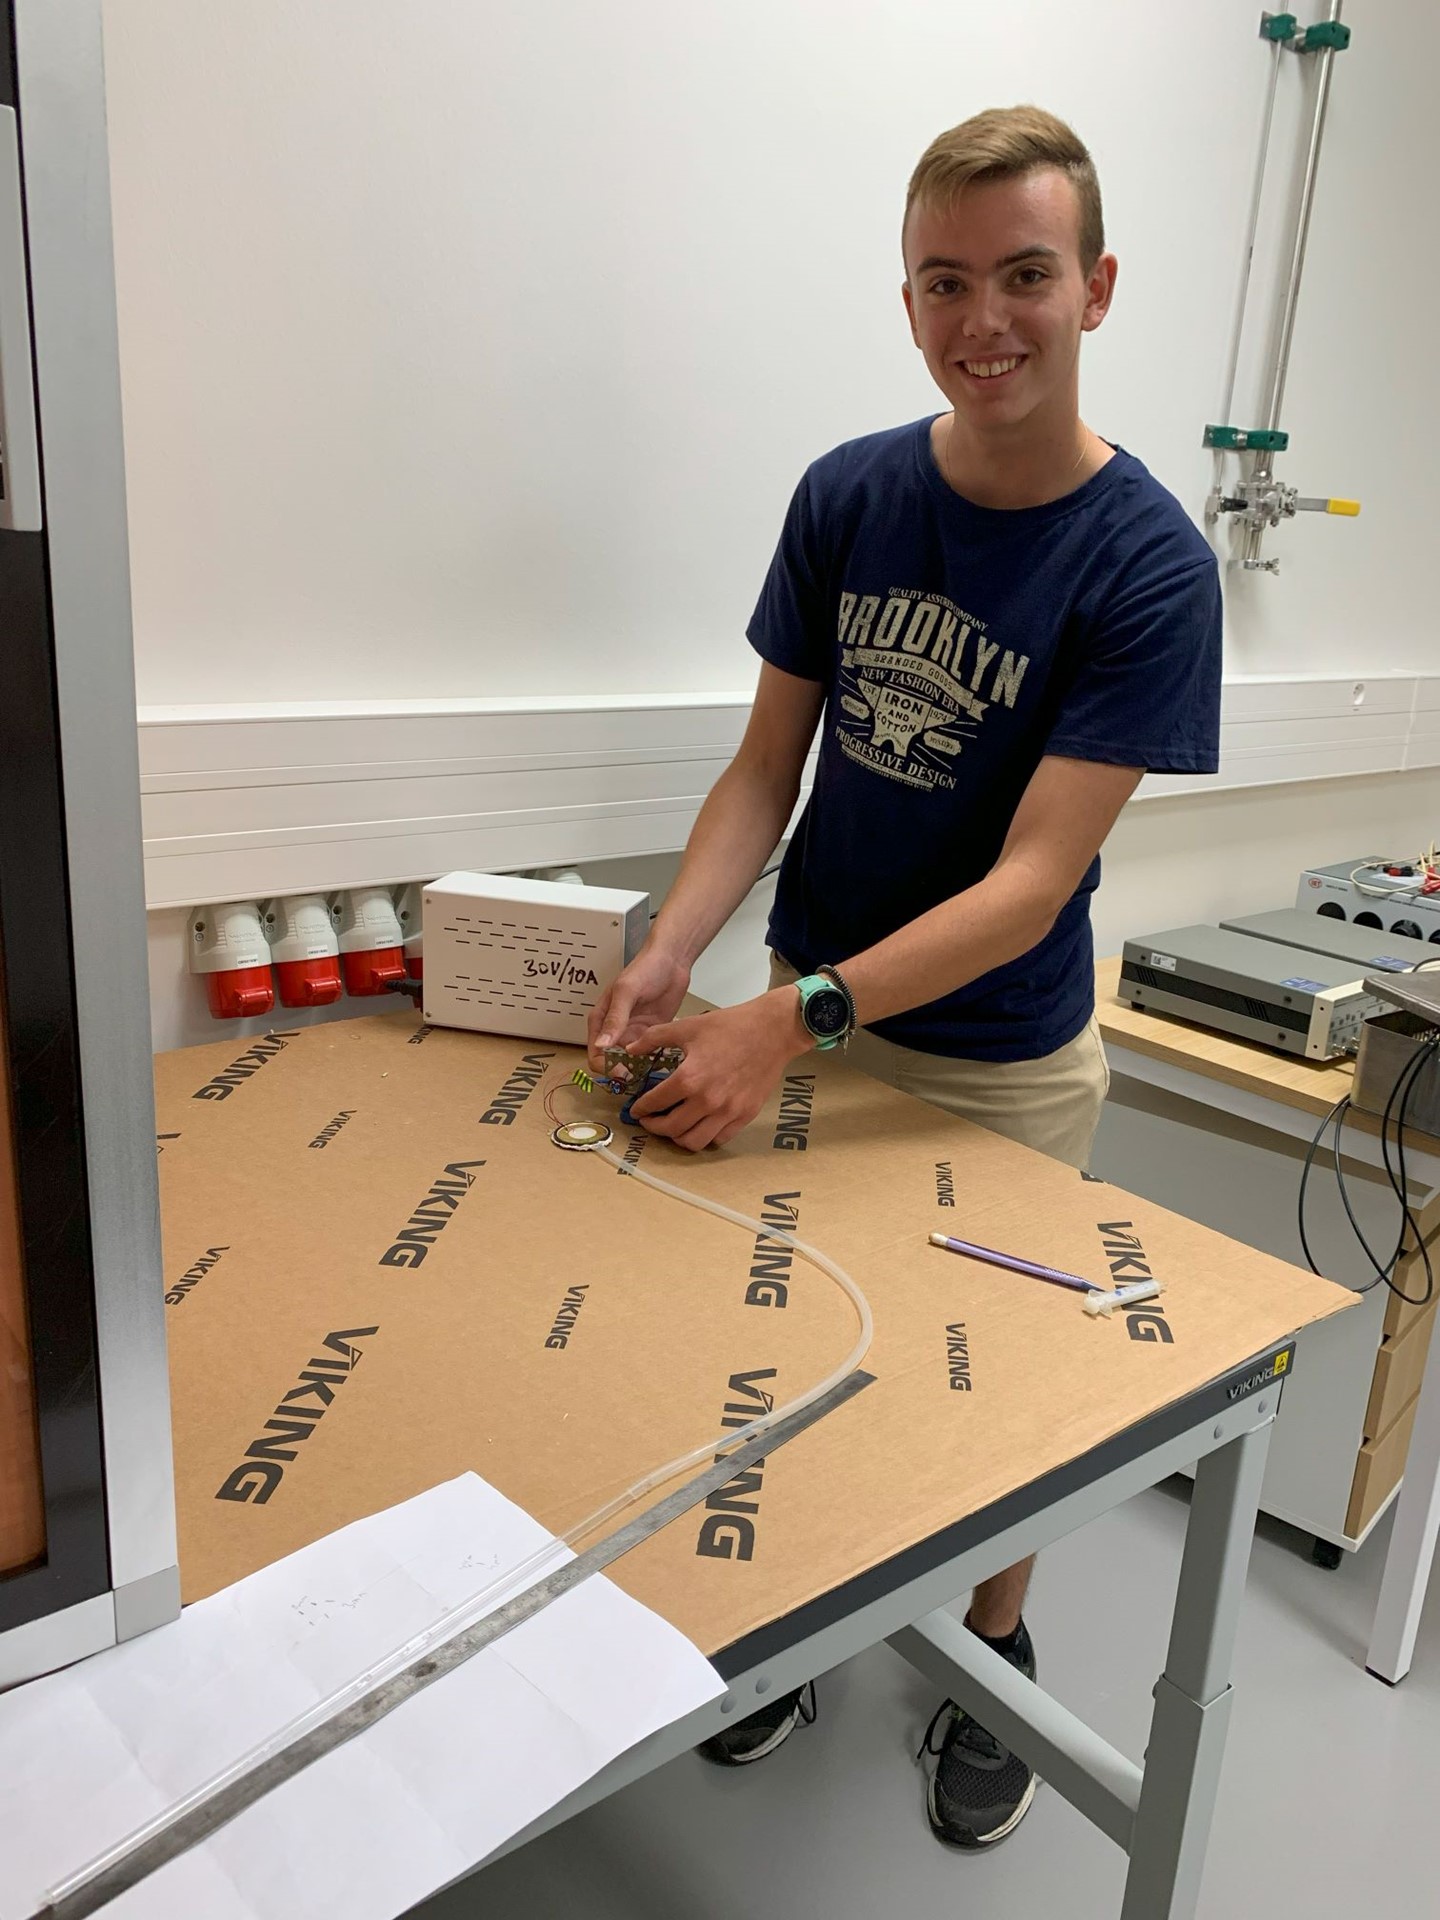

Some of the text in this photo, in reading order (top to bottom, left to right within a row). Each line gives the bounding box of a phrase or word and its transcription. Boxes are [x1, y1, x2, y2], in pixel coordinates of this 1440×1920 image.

[888, 586, 925, 600] QUALITY
[837, 591, 1030, 709] BROOKLYN
[873, 653, 953, 691] BRANDED GOODS
[860, 666, 960, 716] NEW FASHION ERA
[884, 691, 924, 716] IRON
[887, 709, 910, 722] AND
[929, 707, 948, 722] 1974
[876, 711, 917, 733] COTTON
[835, 725, 905, 771] PROGRESSIVE
[906, 762, 958, 790] DESIGN
[522, 958, 599, 986] 30V/10A
[191, 1032, 301, 1101] VIKING
[479, 1053, 556, 1126] VIKING
[308, 1110, 357, 1149] VIKING
[773, 1074, 816, 1151] VIKING
[934, 1161, 955, 1208] VIKING
[378, 1159, 487, 1269] VIKING
[164, 1246, 230, 1305] VIKING
[544, 1284, 590, 1350] VIKING
[945, 1322, 972, 1392] VIKING
[1226, 1367, 1275, 1400] VIKING
[213, 1325, 380, 1505] VIKING
